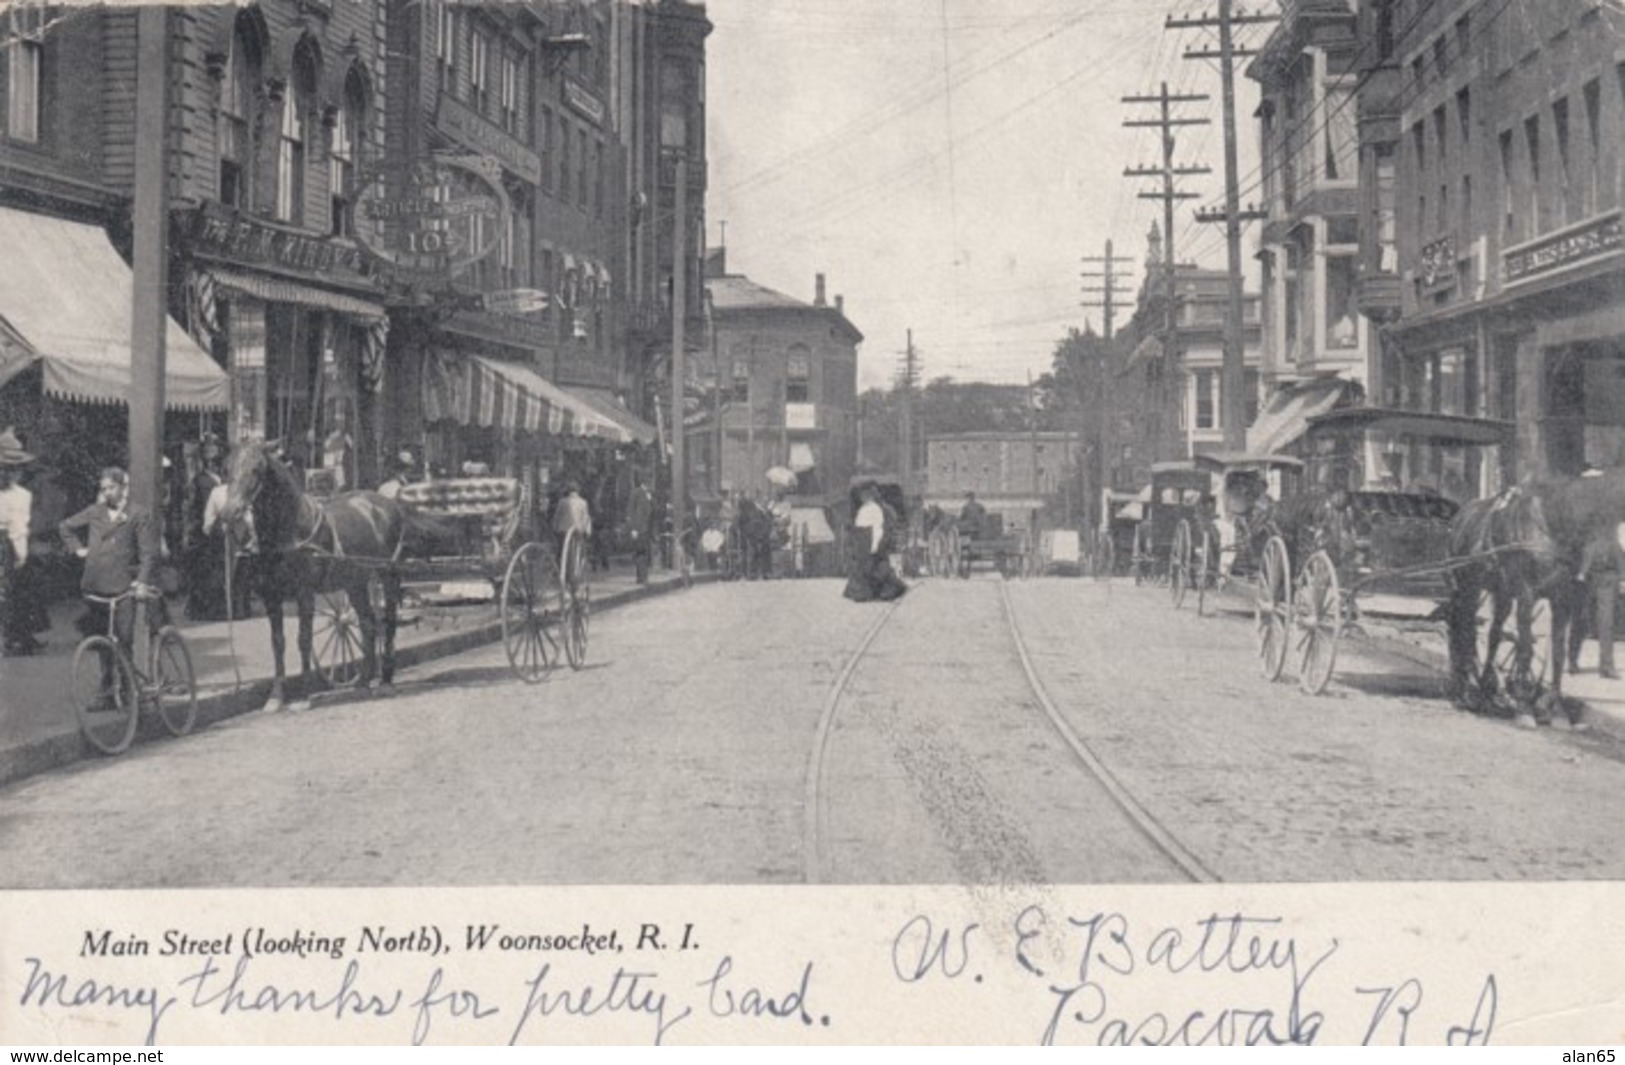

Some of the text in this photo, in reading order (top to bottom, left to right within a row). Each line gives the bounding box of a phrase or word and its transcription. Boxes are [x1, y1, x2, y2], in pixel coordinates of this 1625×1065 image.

[20, 957, 177, 1046] Many
[178, 956, 402, 1018] thanks
[409, 967, 499, 1046] for
[509, 963, 691, 1046] pretty
